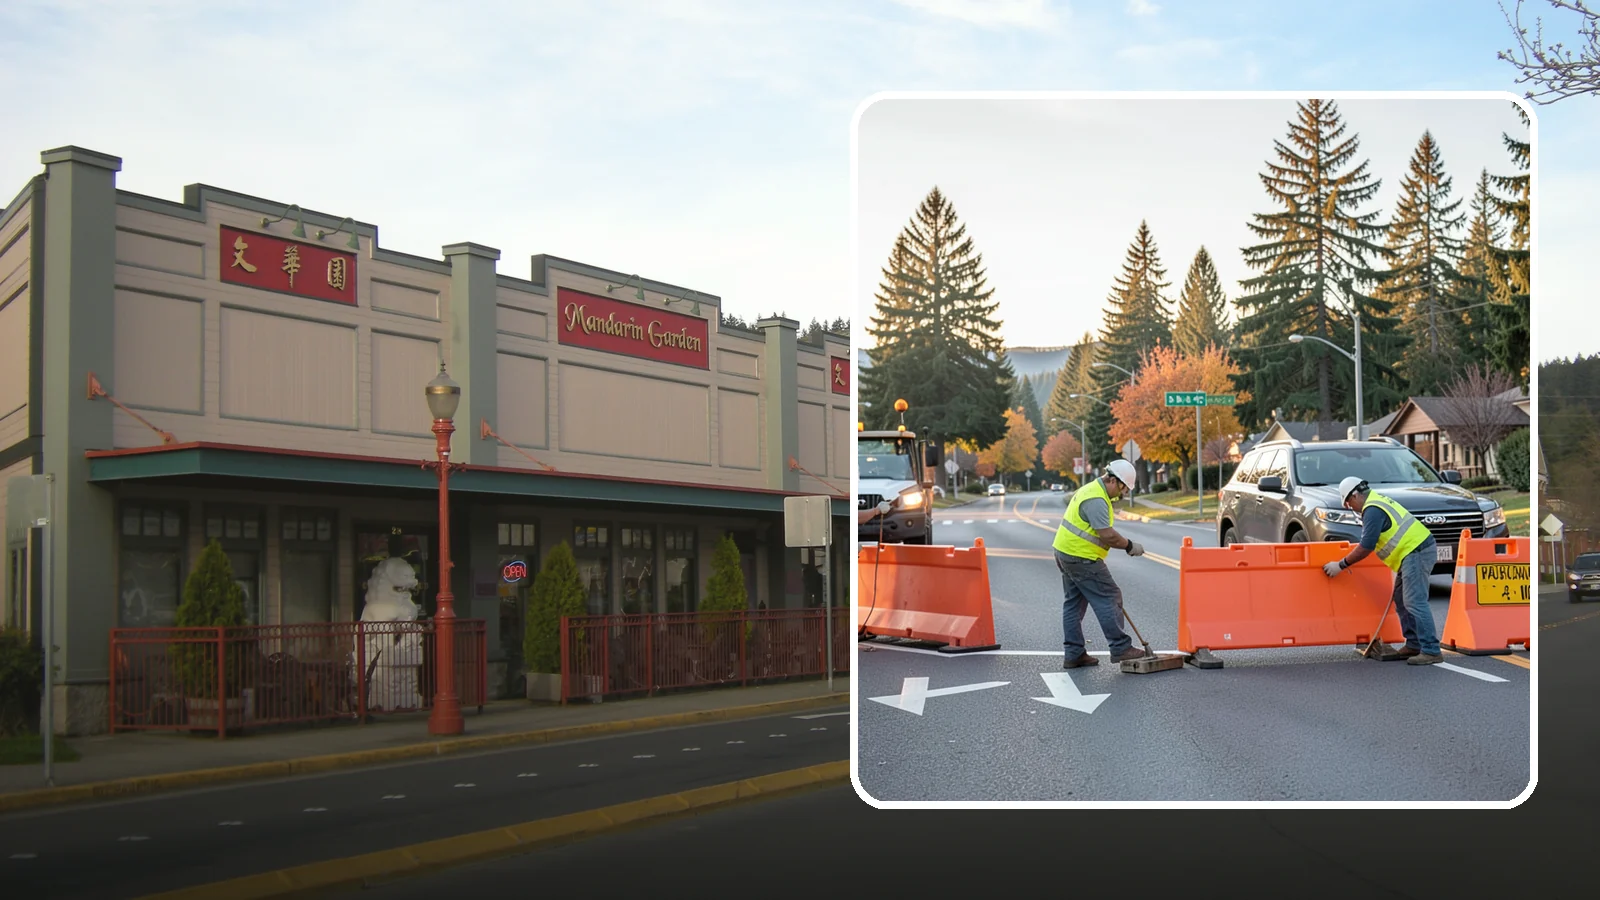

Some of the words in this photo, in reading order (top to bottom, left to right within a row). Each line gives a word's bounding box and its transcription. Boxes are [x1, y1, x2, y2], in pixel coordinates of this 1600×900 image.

[231, 235, 346, 291] 文華園
[564, 302, 644, 341] Mandarin
[647, 320, 701, 352] Garden
[503, 565, 527, 578] OPEN
